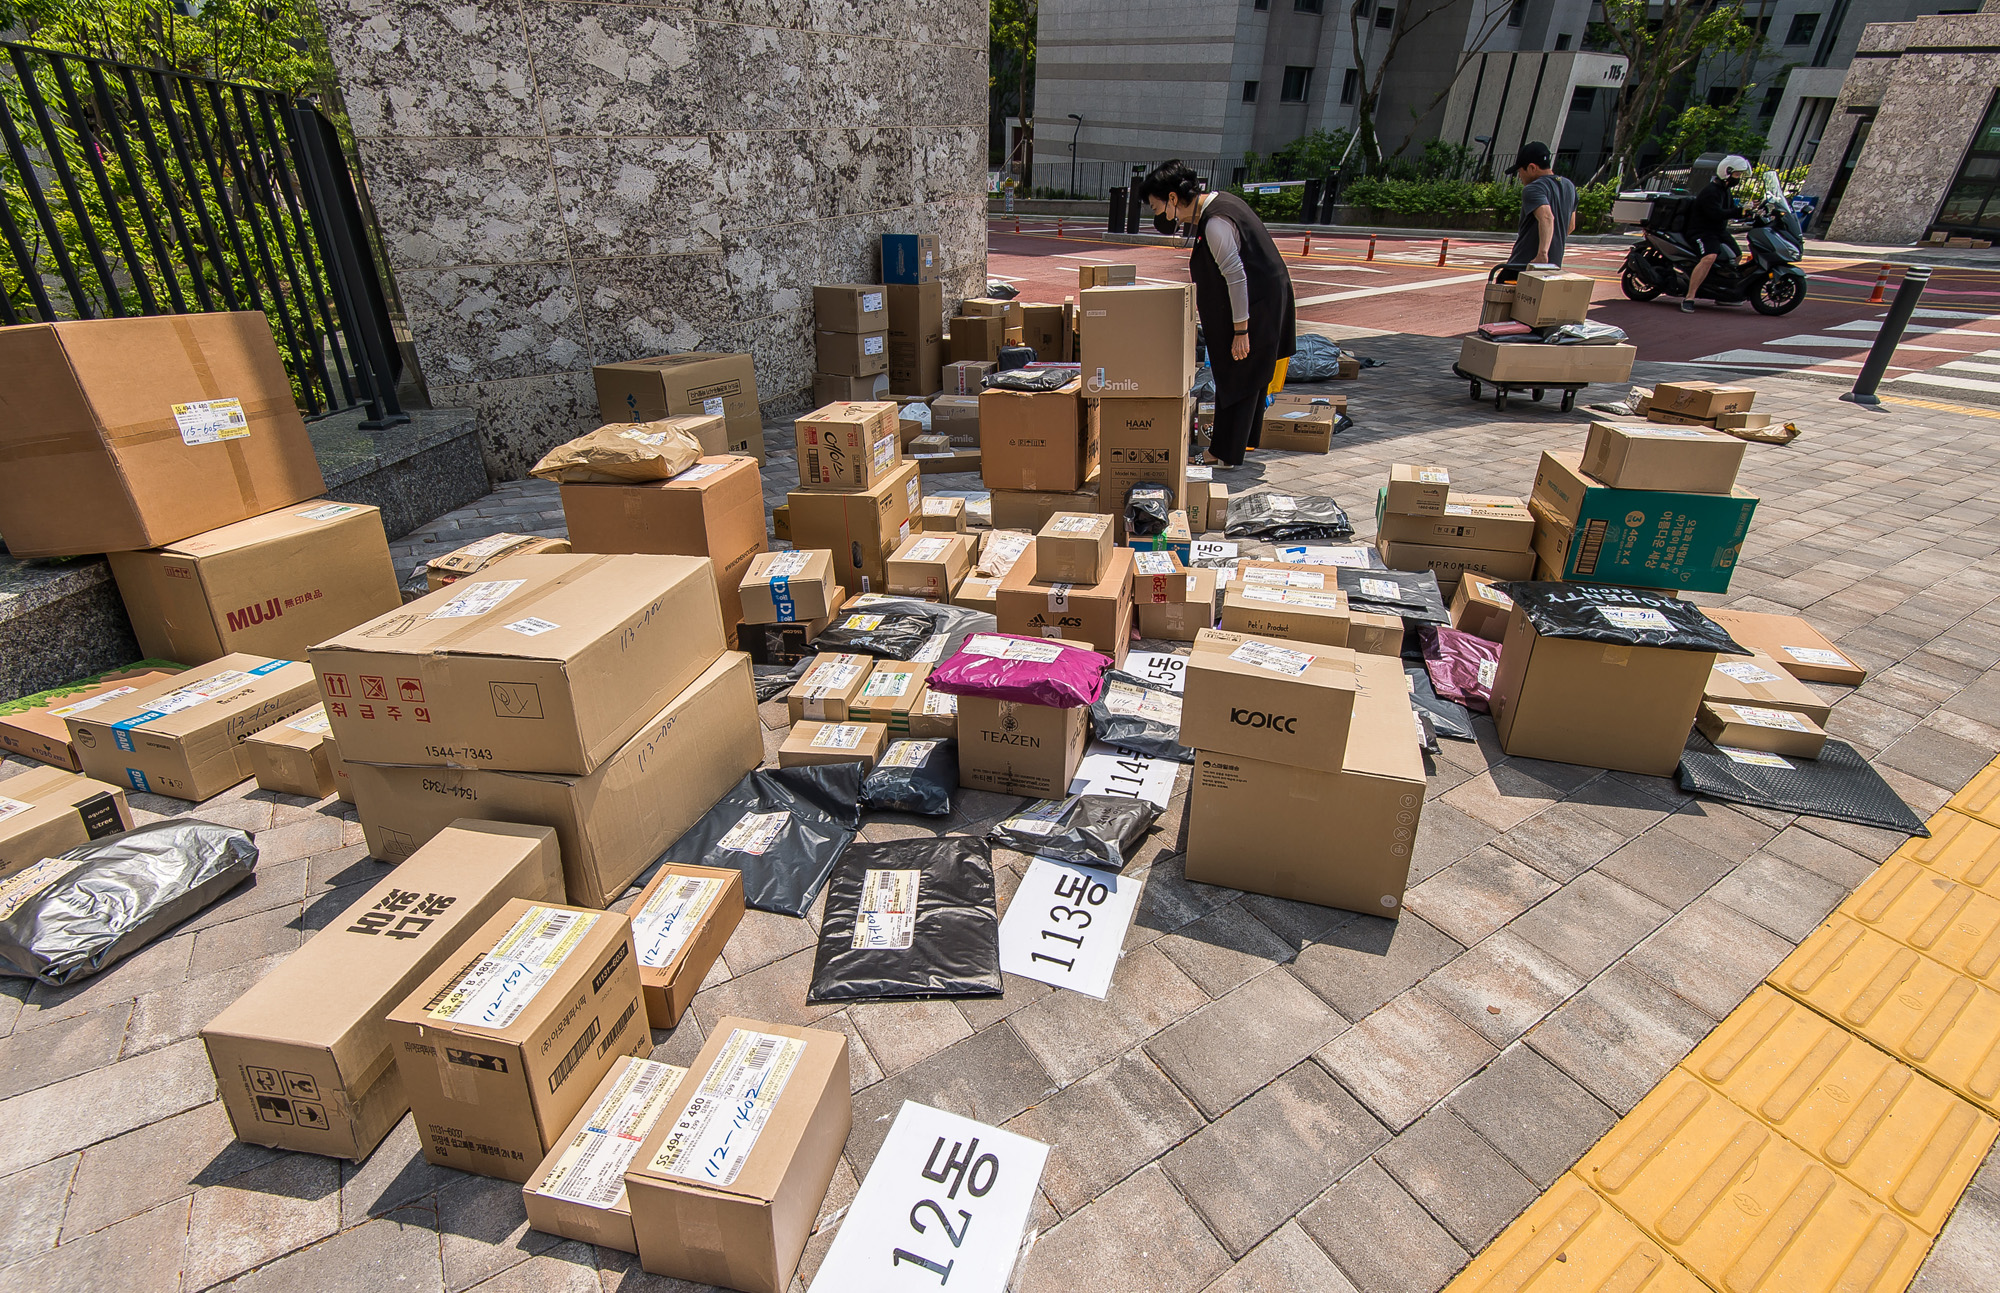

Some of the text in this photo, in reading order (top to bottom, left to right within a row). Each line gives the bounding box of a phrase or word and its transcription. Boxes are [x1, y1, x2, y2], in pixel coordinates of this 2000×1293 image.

[1104, 379, 1139, 391] Smile
[1126, 419, 1152, 428] HAAN
[1643, 510, 1675, 568] 아름다운 세상
[1427, 560, 1488, 572] MPROMISE
[284, 588, 323, 609] 無印良品
[1575, 586, 1632, 595] SEOUL
[225, 597, 283, 632] MUJI
[1057, 616, 1082, 627] ACS
[1247, 619, 1289, 632] Pet's Product
[980, 730, 1040, 748] TEAZEN
[424, 745, 493, 760] 1544-7343
[1211, 761, 1240, 772] 스마일배송
[422, 778, 478, 801] 1544-7343
[1031, 874, 1108, 972] 113동
[595, 946, 627, 988] 11131-6037
[437, 1004, 452, 1014] SS
[450, 988, 468, 1004] 494
[475, 961, 494, 977] 480
[725, 1083, 735, 1096] Z99
[691, 1119, 700, 1130] Z99
[705, 1067, 771, 1177] 112-1402
[428, 1124, 463, 1138] 11131-6037
[656, 1097, 705, 1167] SS 494 B 480
[893, 1137, 999, 1286] 12동
